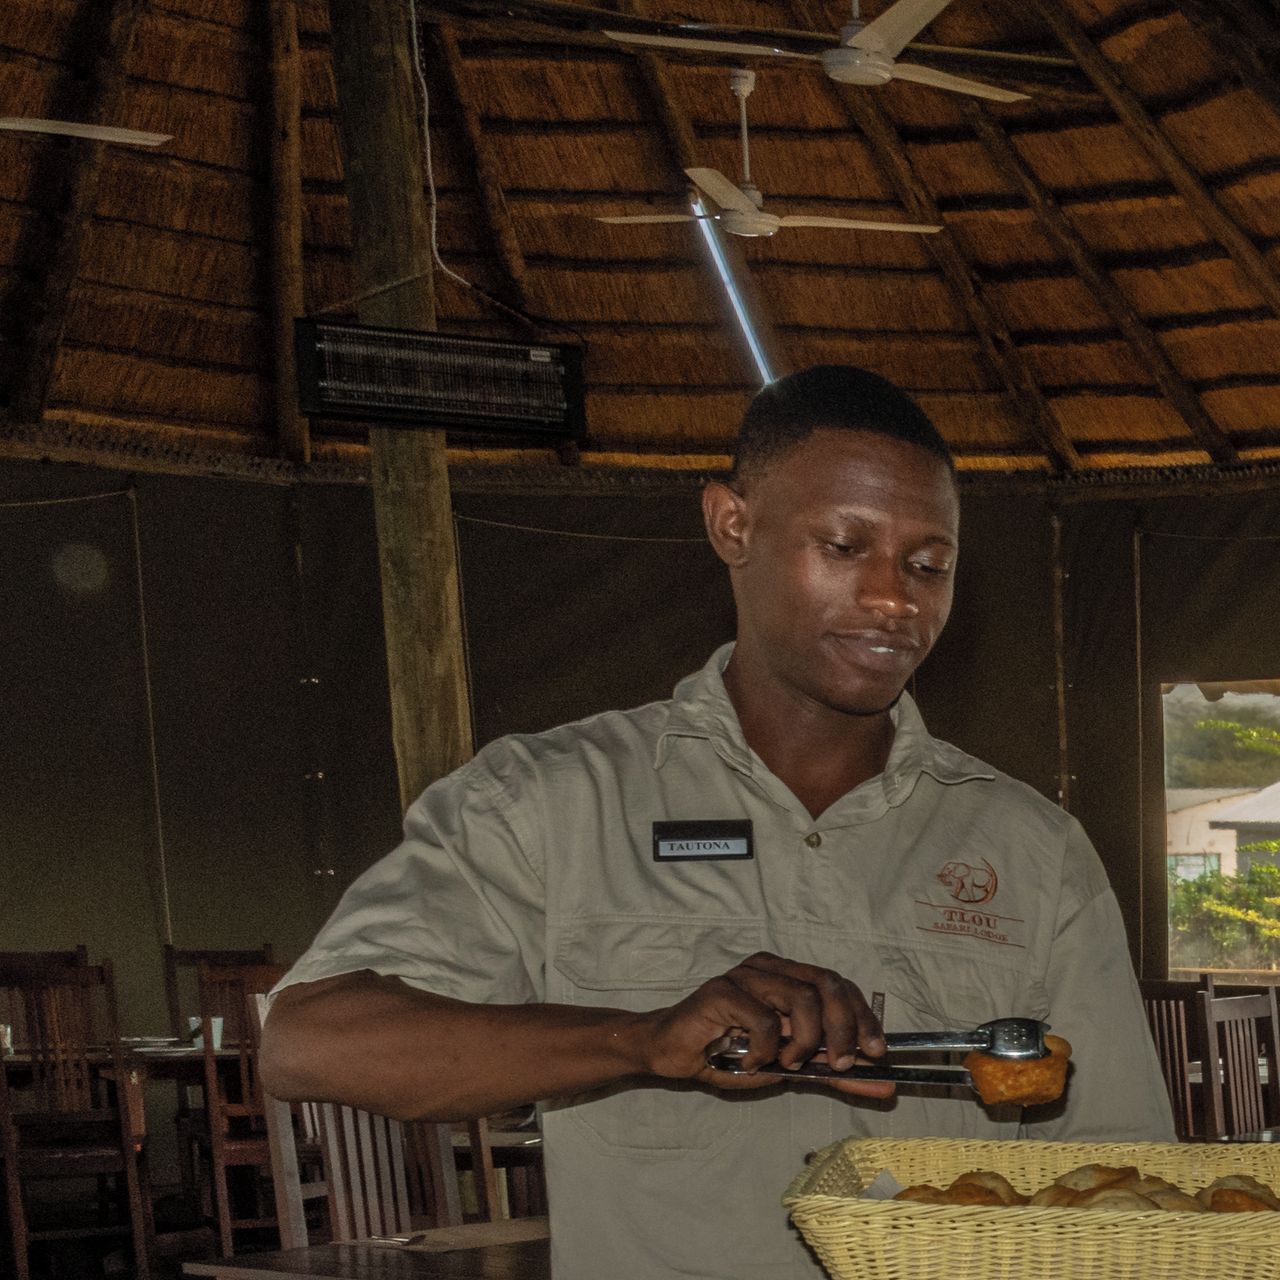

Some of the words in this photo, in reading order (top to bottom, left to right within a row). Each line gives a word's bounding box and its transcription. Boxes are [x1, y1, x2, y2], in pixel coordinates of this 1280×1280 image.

[668, 842, 730, 851] TAUTONA
[943, 910, 998, 929] TLOU
[933, 922, 970, 933] SAFARI
[975, 928, 1008, 942] LODGE
